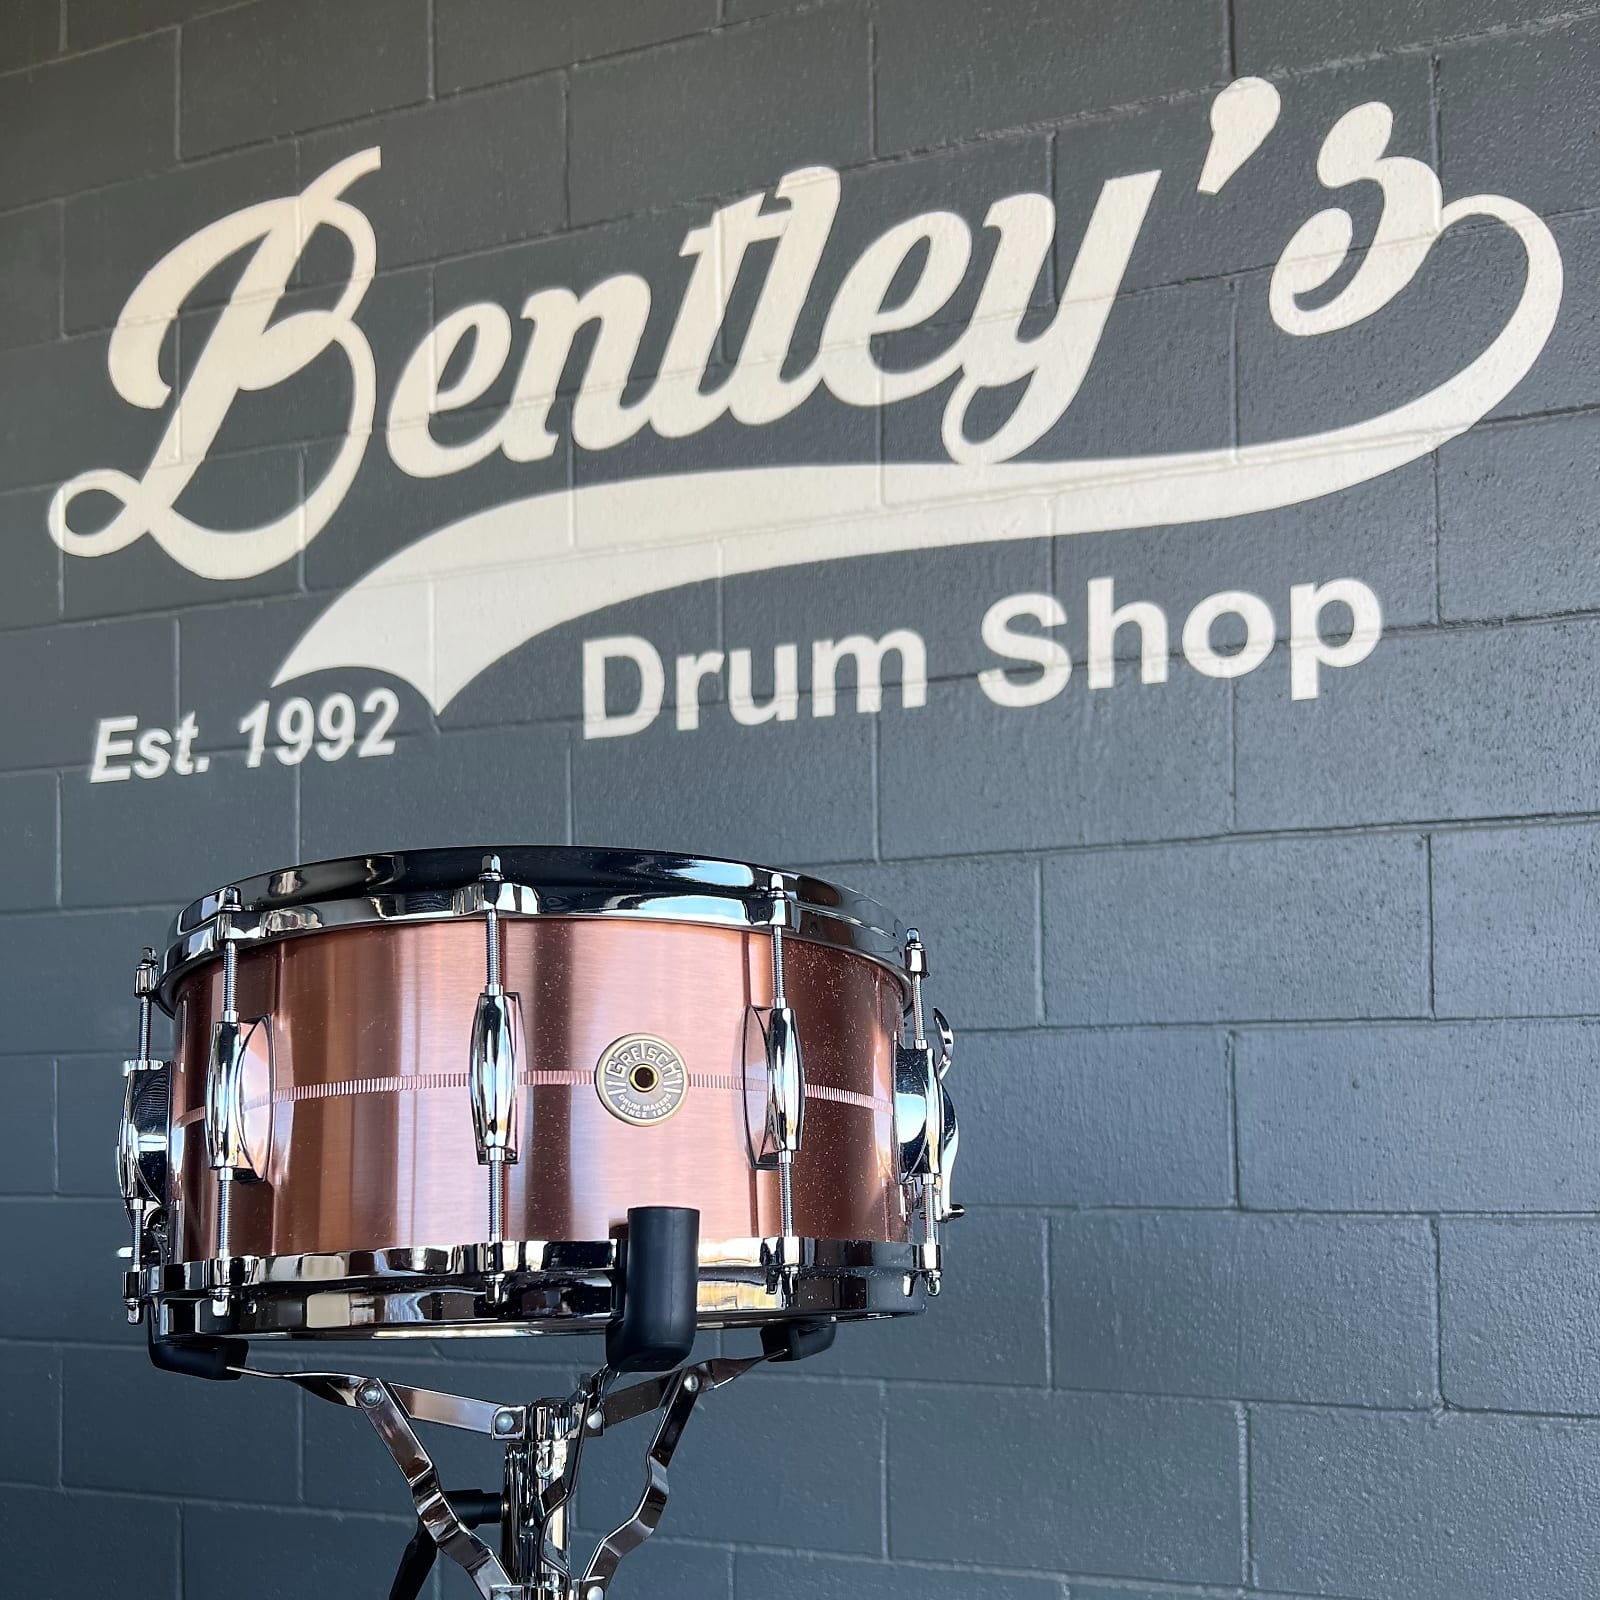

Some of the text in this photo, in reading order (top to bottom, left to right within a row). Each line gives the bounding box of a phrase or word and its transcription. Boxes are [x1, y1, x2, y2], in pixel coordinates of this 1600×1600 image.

[47, 75, 1564, 581] Bentley's
[582, 575, 1385, 740] Drum Shop
[89, 687, 400, 785] Est. 1992
[605, 1042, 681, 1079] GRETSCH
[618, 1093, 673, 1112] DRUM MAKERS
[619, 1104, 673, 1117] SINCE 1883
